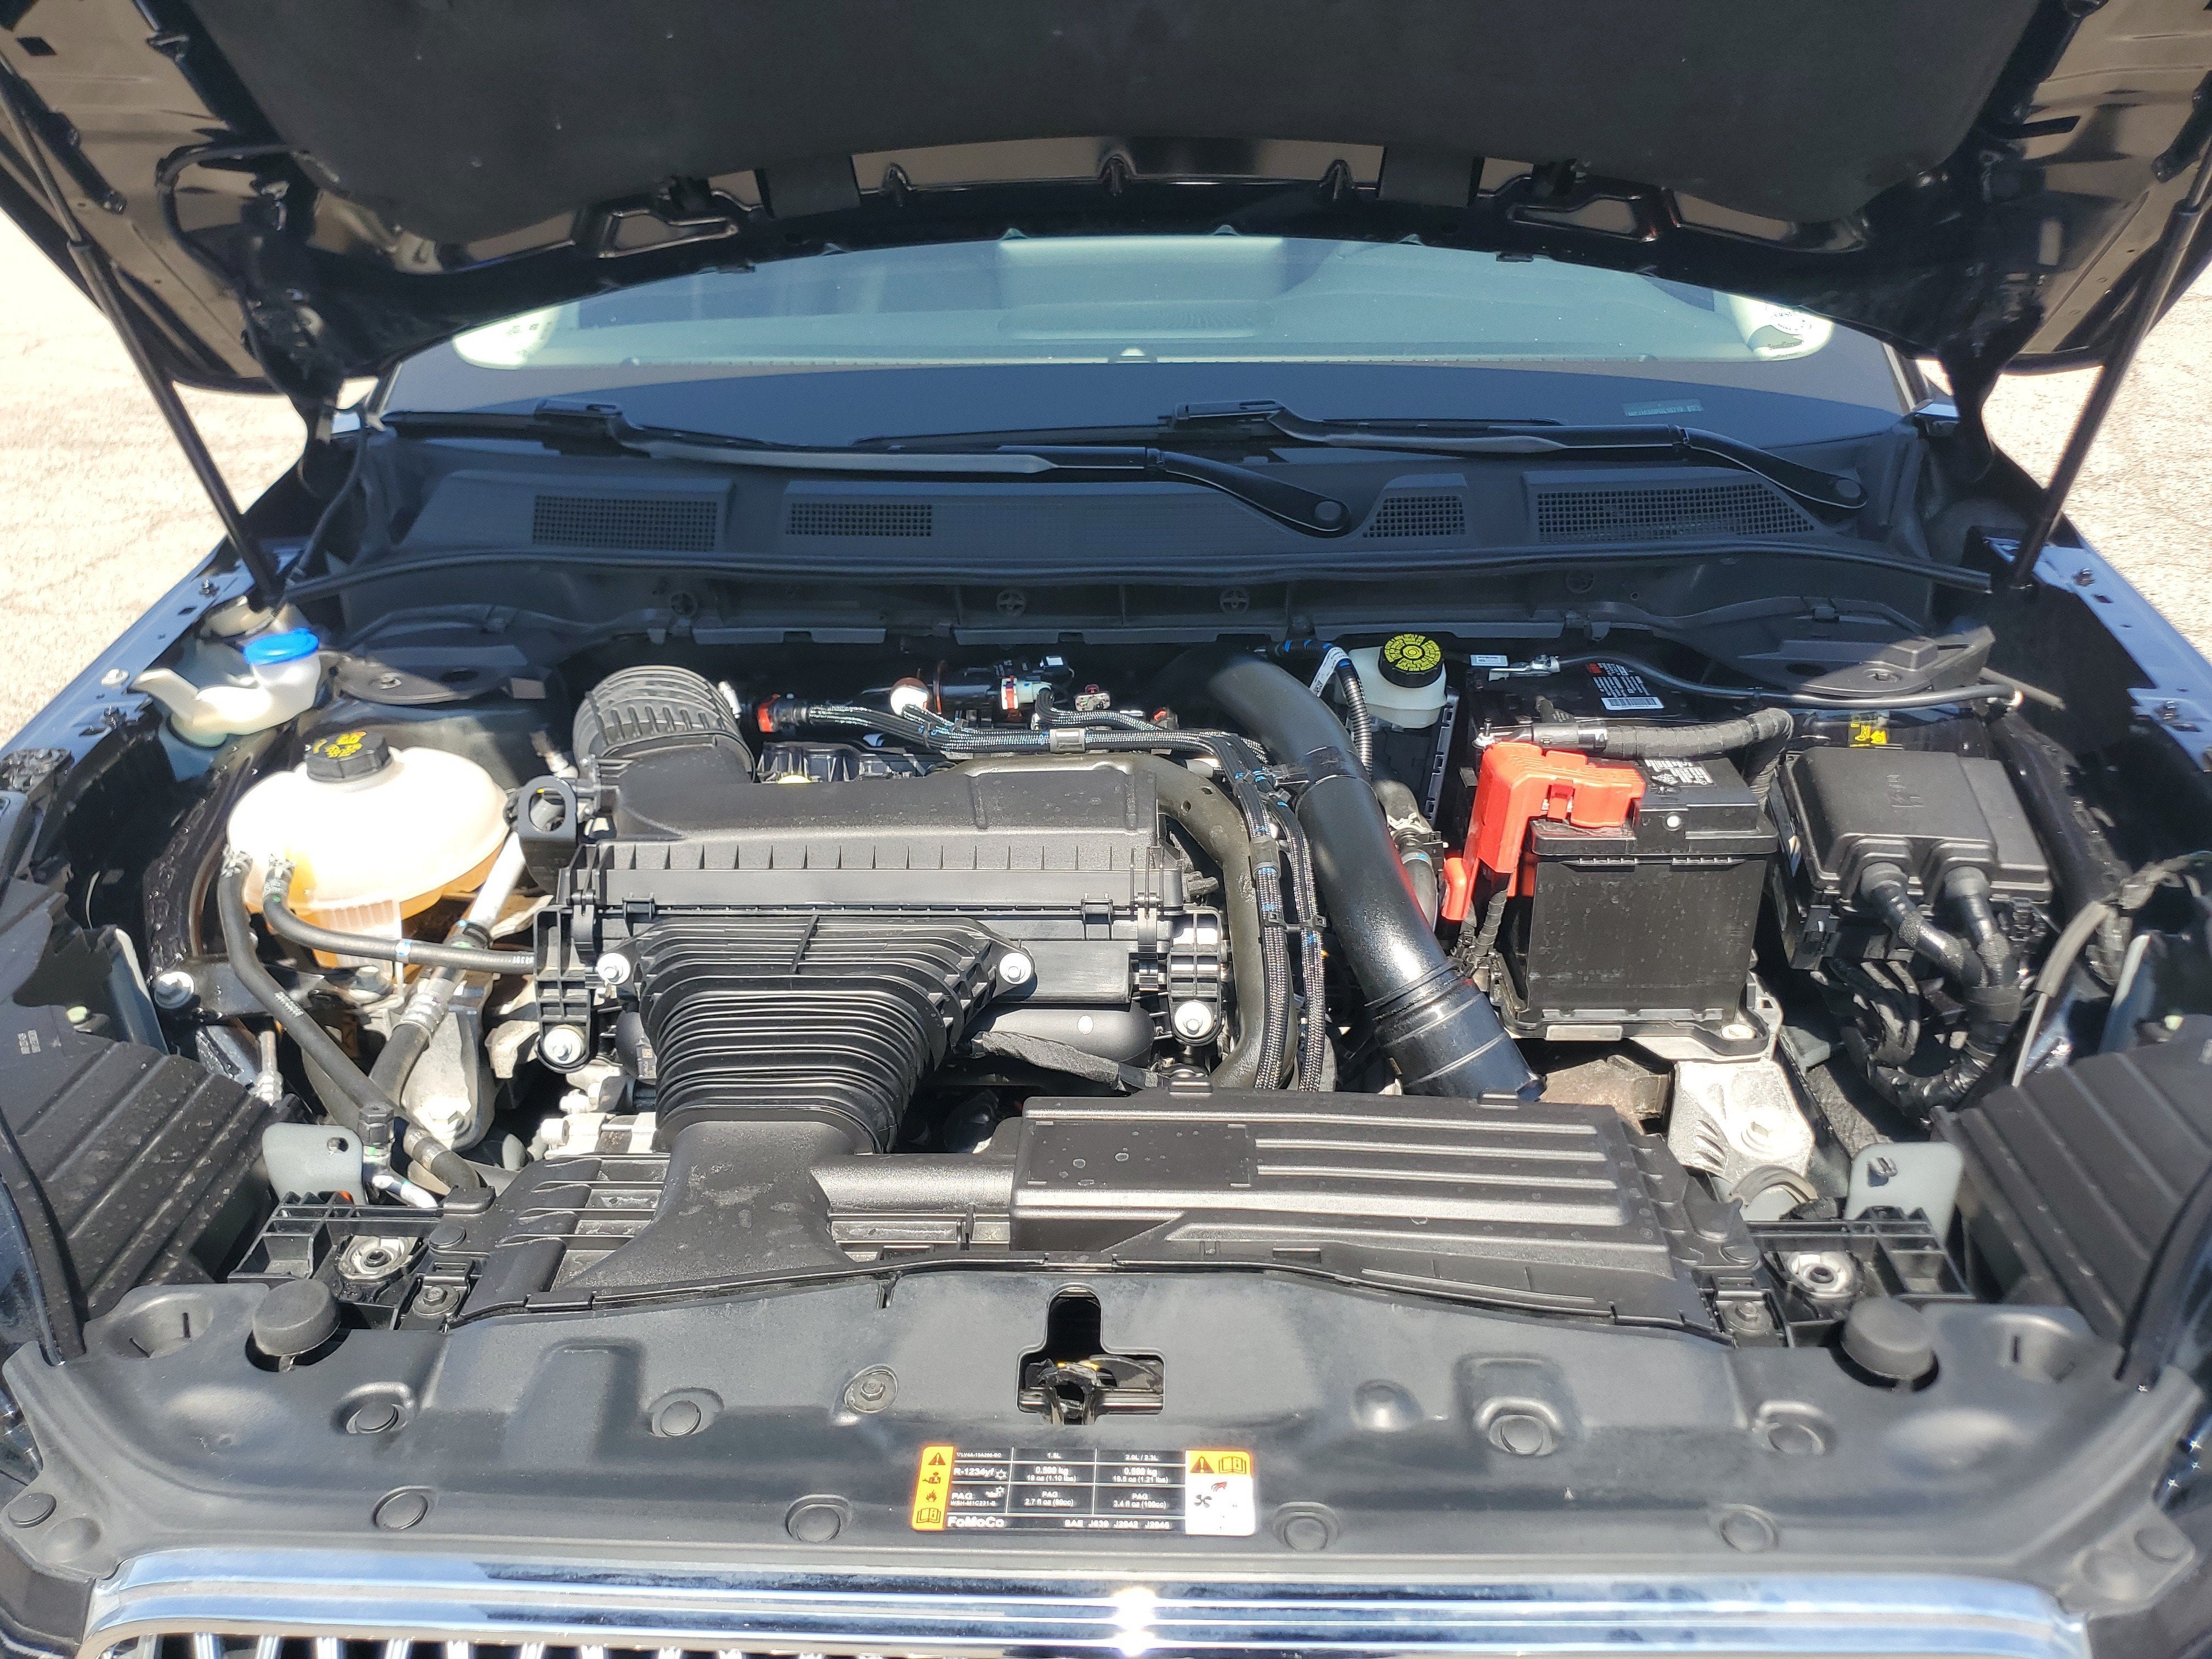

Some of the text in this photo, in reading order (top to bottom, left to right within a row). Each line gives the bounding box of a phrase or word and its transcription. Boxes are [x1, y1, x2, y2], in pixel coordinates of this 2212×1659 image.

[953, 1467, 995, 1478] R-1234yf
[1058, 1466, 1069, 1476] kg
[1147, 1467, 1158, 1477] kg
[947, 1516, 1005, 1527] FoMoCo
[1064, 1519, 1084, 1527] SAE
